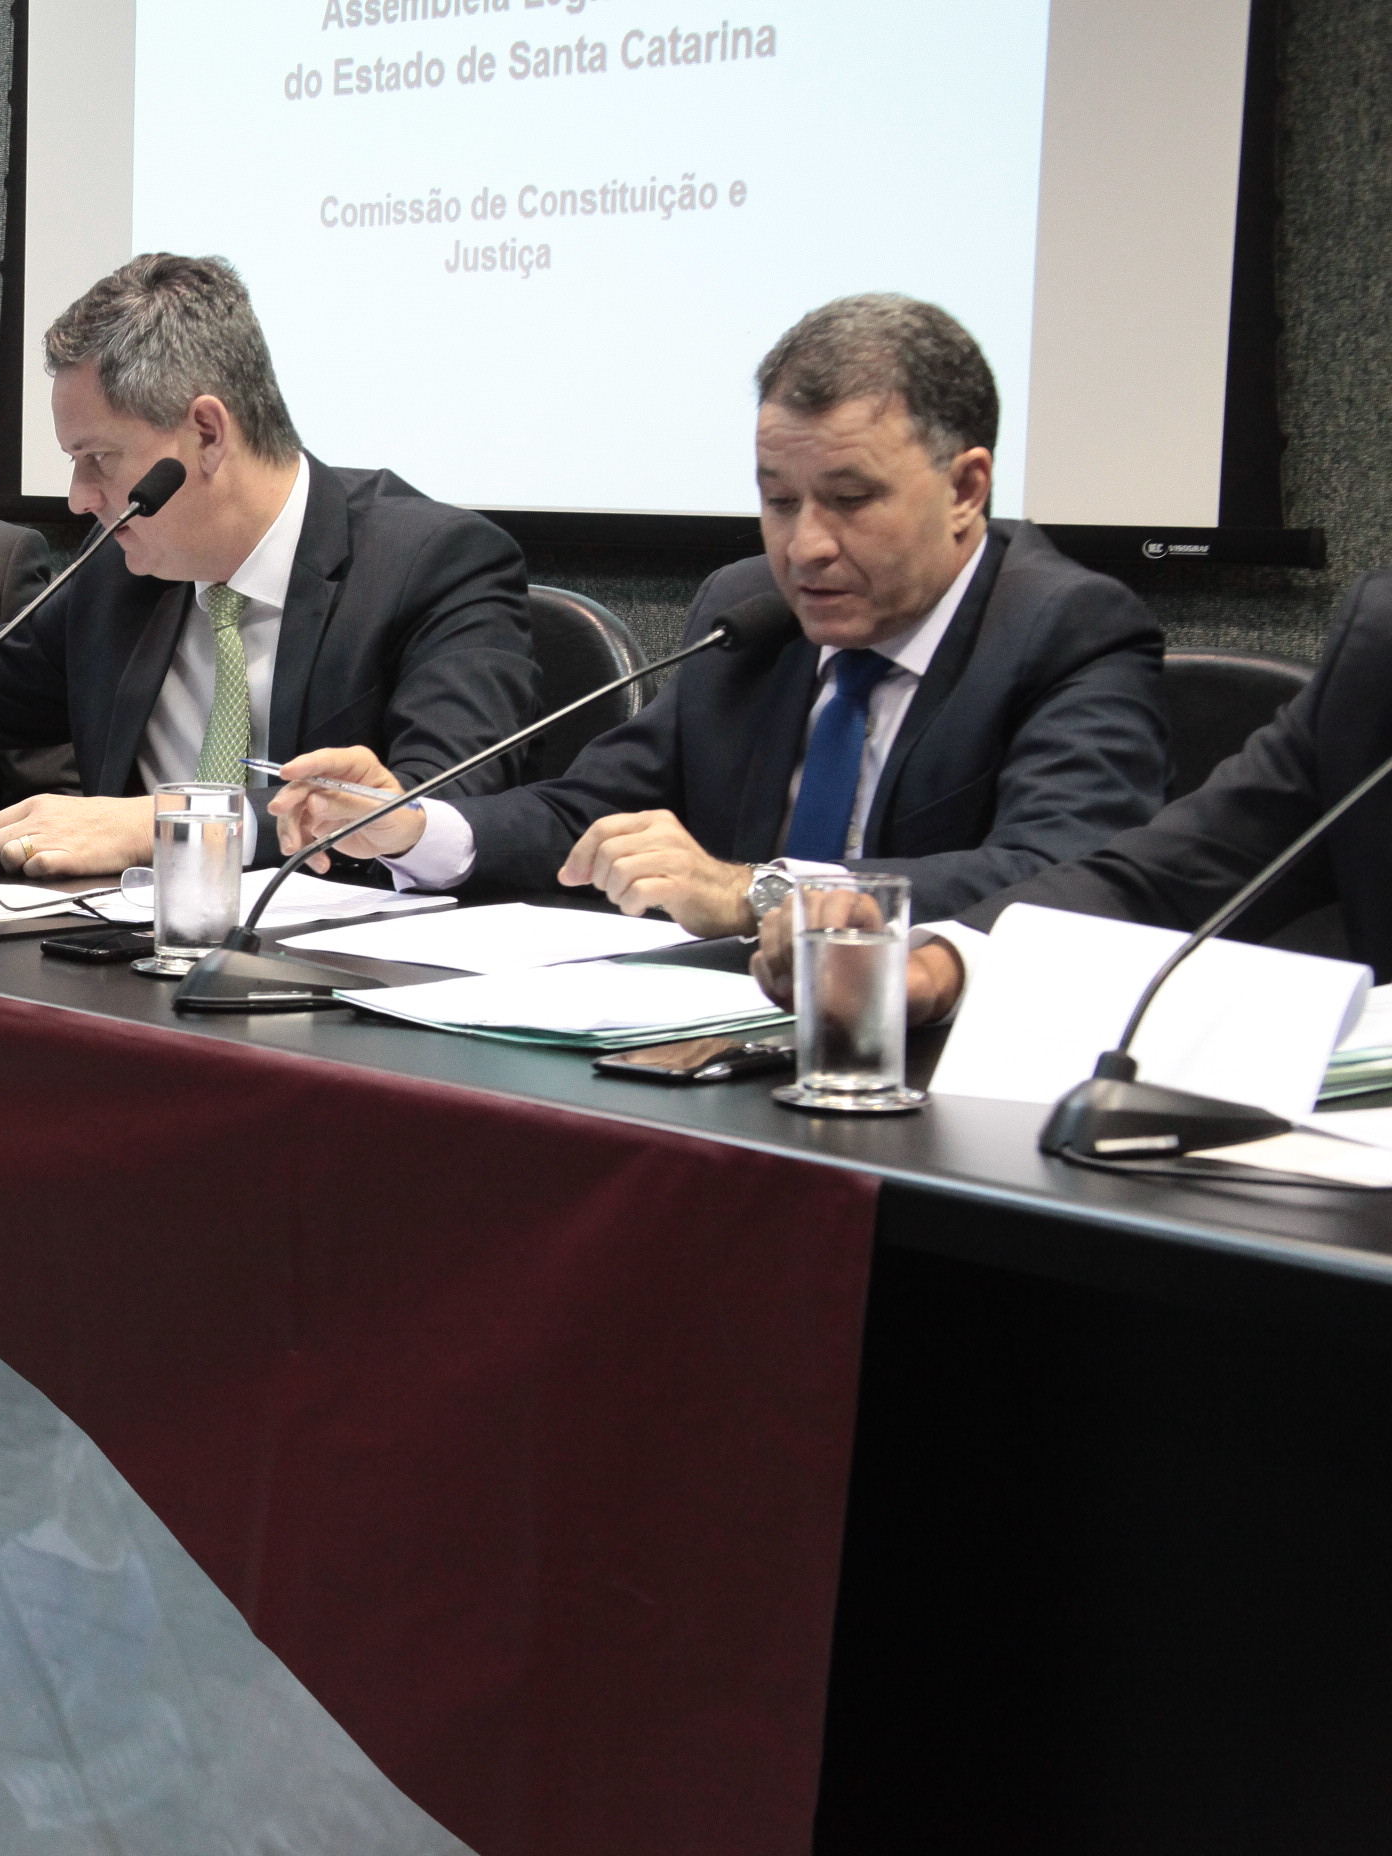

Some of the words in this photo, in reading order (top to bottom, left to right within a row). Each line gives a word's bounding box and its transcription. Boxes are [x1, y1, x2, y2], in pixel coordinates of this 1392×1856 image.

[284, 63, 323, 101] do
[333, 50, 446, 96] Estado
[456, 44, 497, 85] de
[508, 35, 608, 81] Santa
[620, 19, 778, 70] Catarina
[320, 187, 462, 228] Comissão
[470, 186, 507, 221] de
[517, 172, 719, 221] Constituição
[728, 179, 748, 208] e
[444, 237, 551, 280] Justiça
